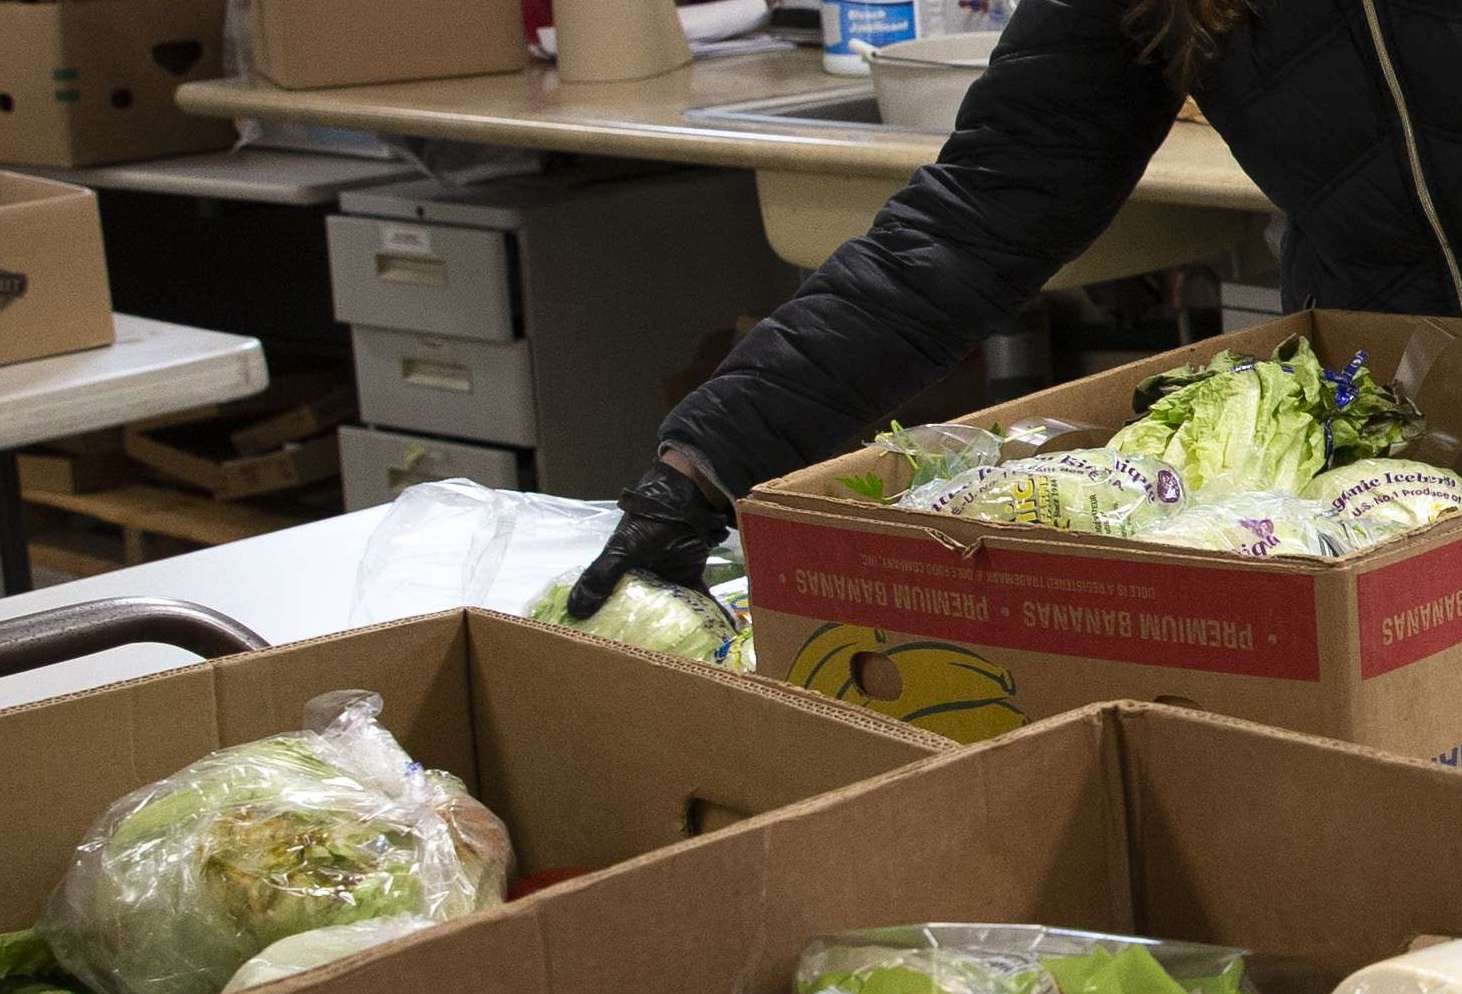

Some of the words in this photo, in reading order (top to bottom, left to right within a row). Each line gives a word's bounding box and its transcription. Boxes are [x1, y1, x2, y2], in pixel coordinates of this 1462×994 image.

[1332, 478, 1381, 512] ganic
[794, 568, 888, 607] BANANAS
[892, 583, 990, 623] PREMIUM
[1022, 600, 1132, 639] BANANAS
[1138, 612, 1254, 650] PREMIUM
